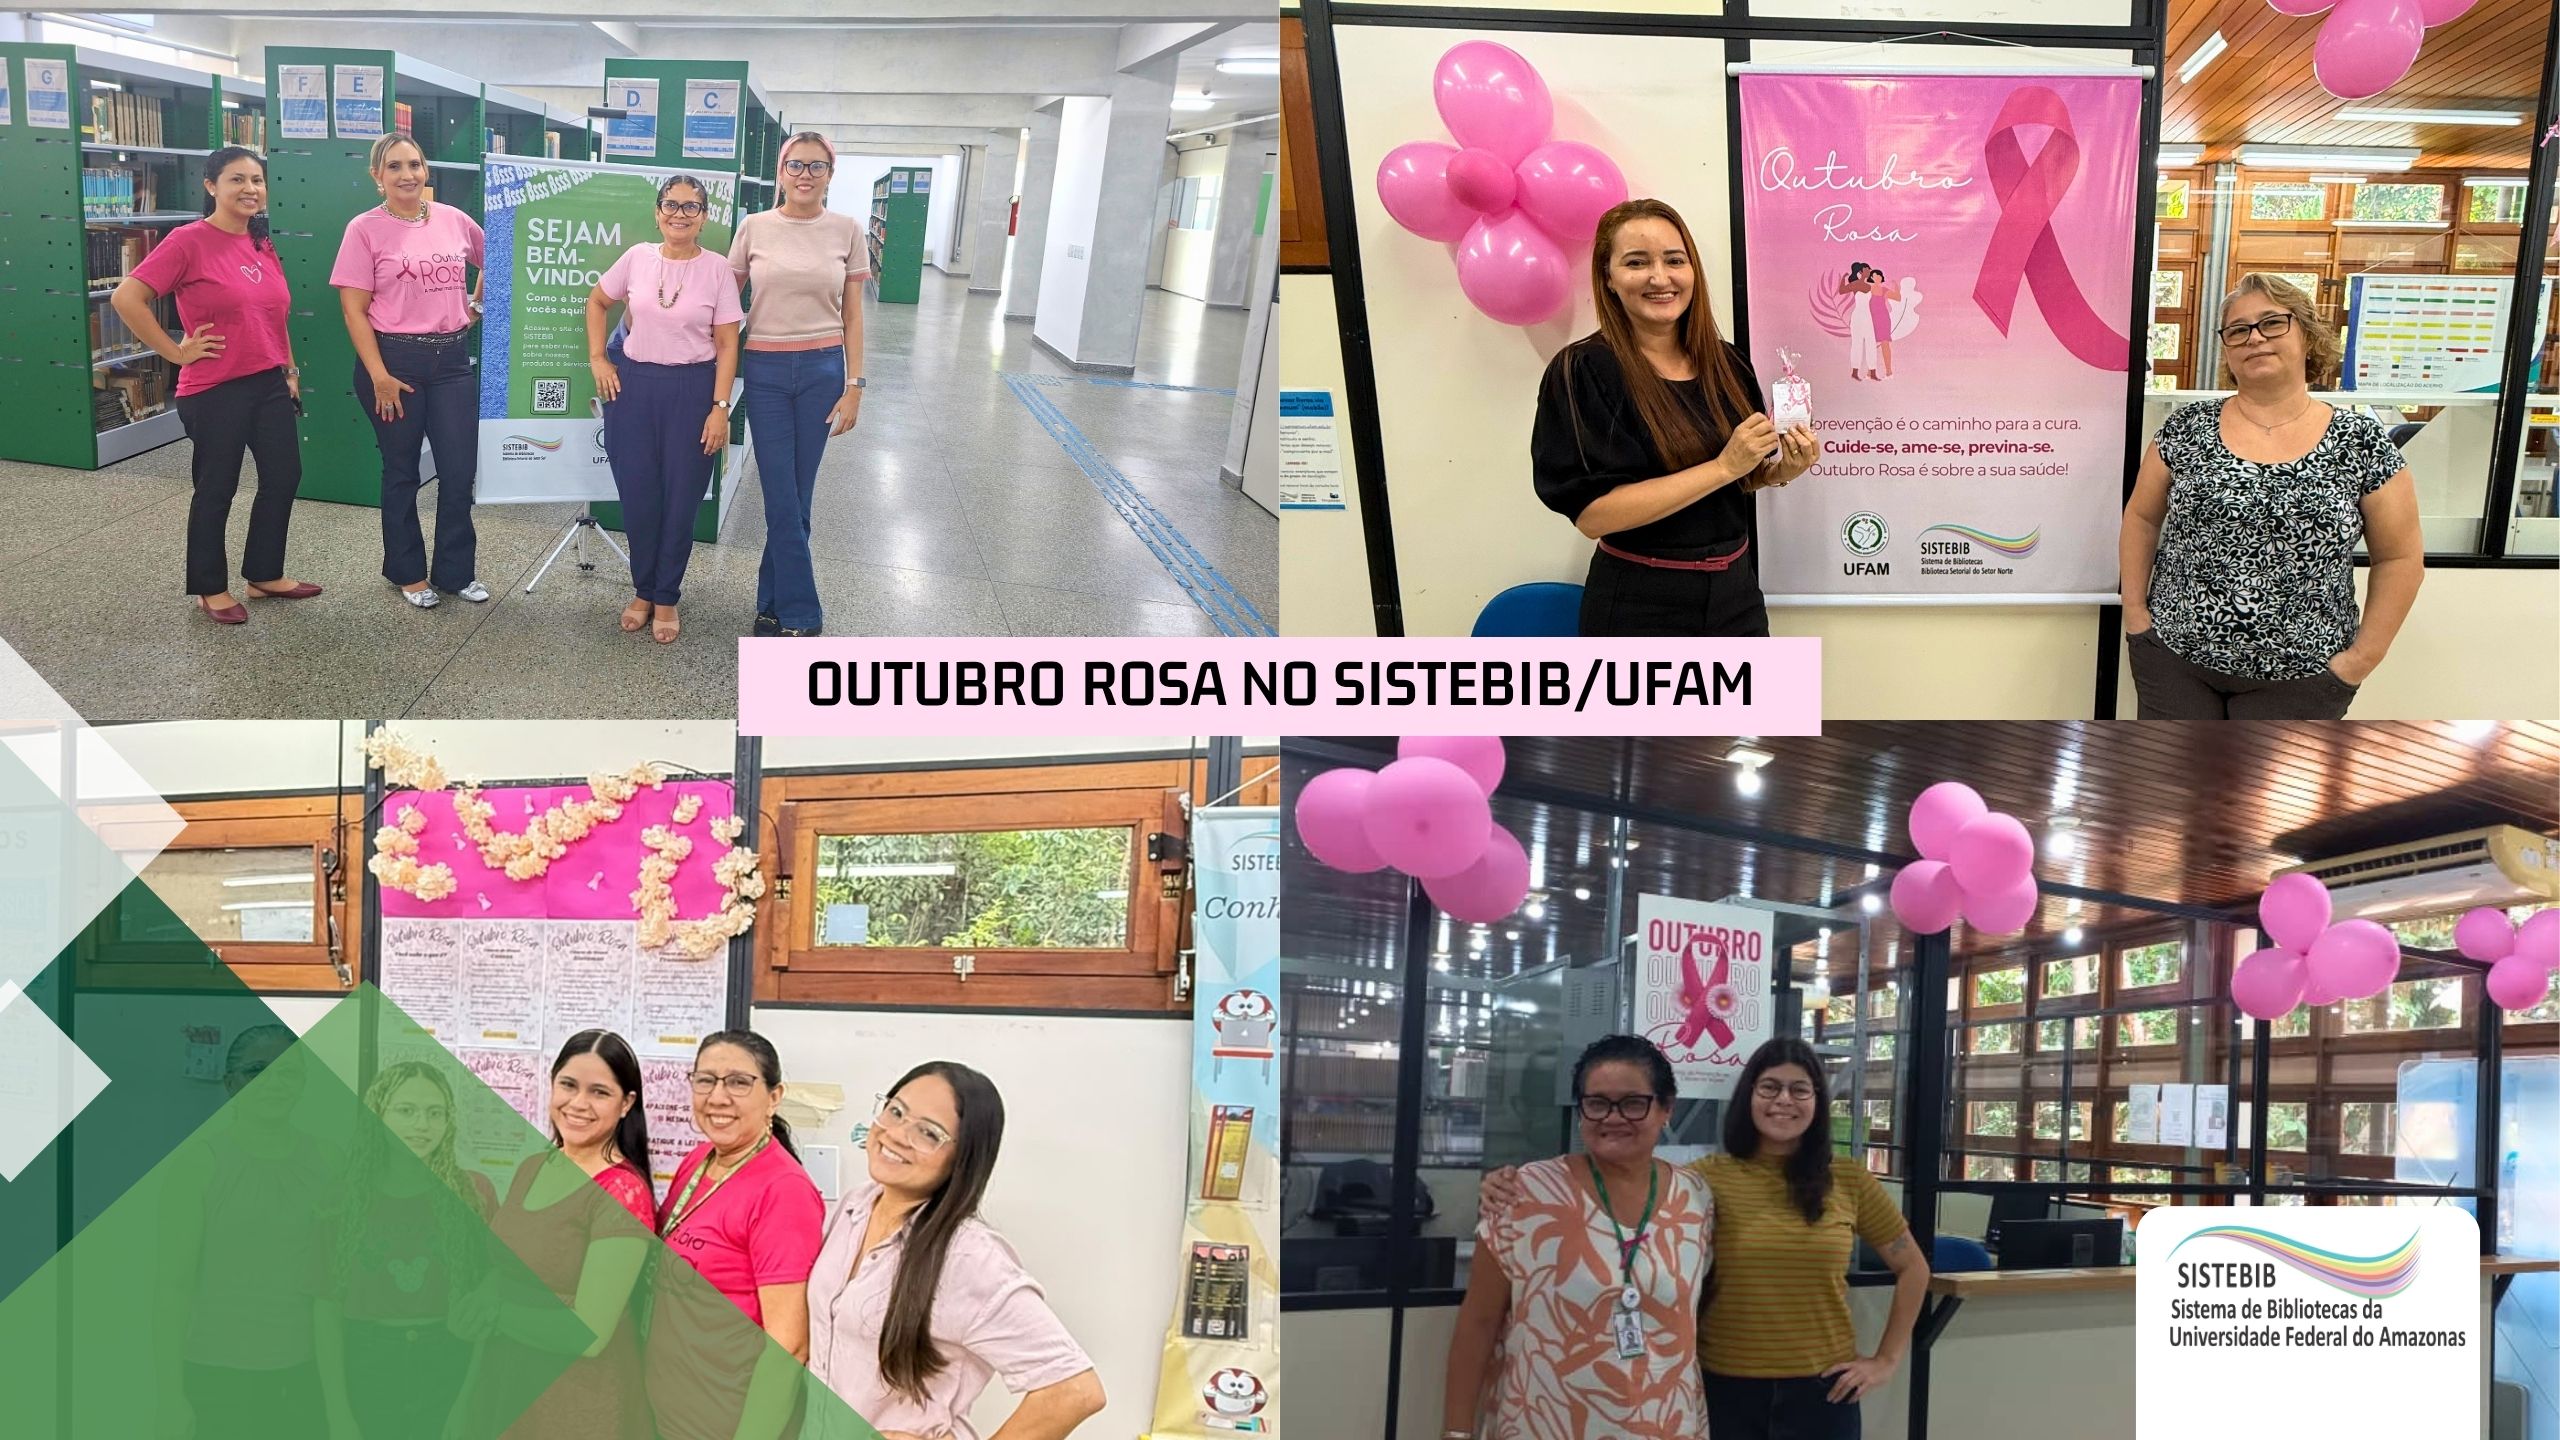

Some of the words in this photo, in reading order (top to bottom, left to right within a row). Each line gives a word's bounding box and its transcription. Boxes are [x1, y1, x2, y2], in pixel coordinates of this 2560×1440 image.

[1760, 146, 1973, 192] Outubro
[1813, 203, 1919, 242] Rosa
[527, 217, 621, 248] SEJAM
[526, 245, 585, 266] BEM-
[525, 266, 601, 288] VINDO
[526, 292, 557, 302] Como
[526, 305, 557, 314] vocês
[560, 306, 586, 316] aqui!
[1896, 416, 1906, 431] é
[1909, 420, 1919, 431] o
[1922, 416, 1992, 431] caminho
[1995, 419, 2029, 434] para
[2032, 419, 2041, 430] a
[2044, 418, 2082, 430] cura.
[502, 443, 528, 451] SISTEBIB
[1823, 440, 1898, 455] Cuide-se,
[1901, 442, 1965, 455] ame-se,
[1968, 439, 2055, 456] previna-se.
[1810, 462, 1875, 476] Outubro
[1878, 462, 1915, 476] Rosa
[1918, 462, 1929, 476] é
[1931, 462, 1974, 476] sobre
[1977, 465, 1987, 476] a
[1989, 465, 2016, 476] sua
[2019, 462, 2069, 476] saúde!
[1920, 541, 1971, 555] SISTEBIB
[1920, 556, 1943, 565] Sistema
[1944, 556, 1952, 565] de
[1952, 556, 1984, 565] Bibliotecas
[1843, 562, 1890, 576] UFAM
[1920, 567, 1949, 575] Biblioteca
[1949, 567, 1972, 575] Setorial
[1972, 567, 1980, 575] do
[1981, 567, 1997, 575] Setor
[1997, 567, 2014, 575] Norte
